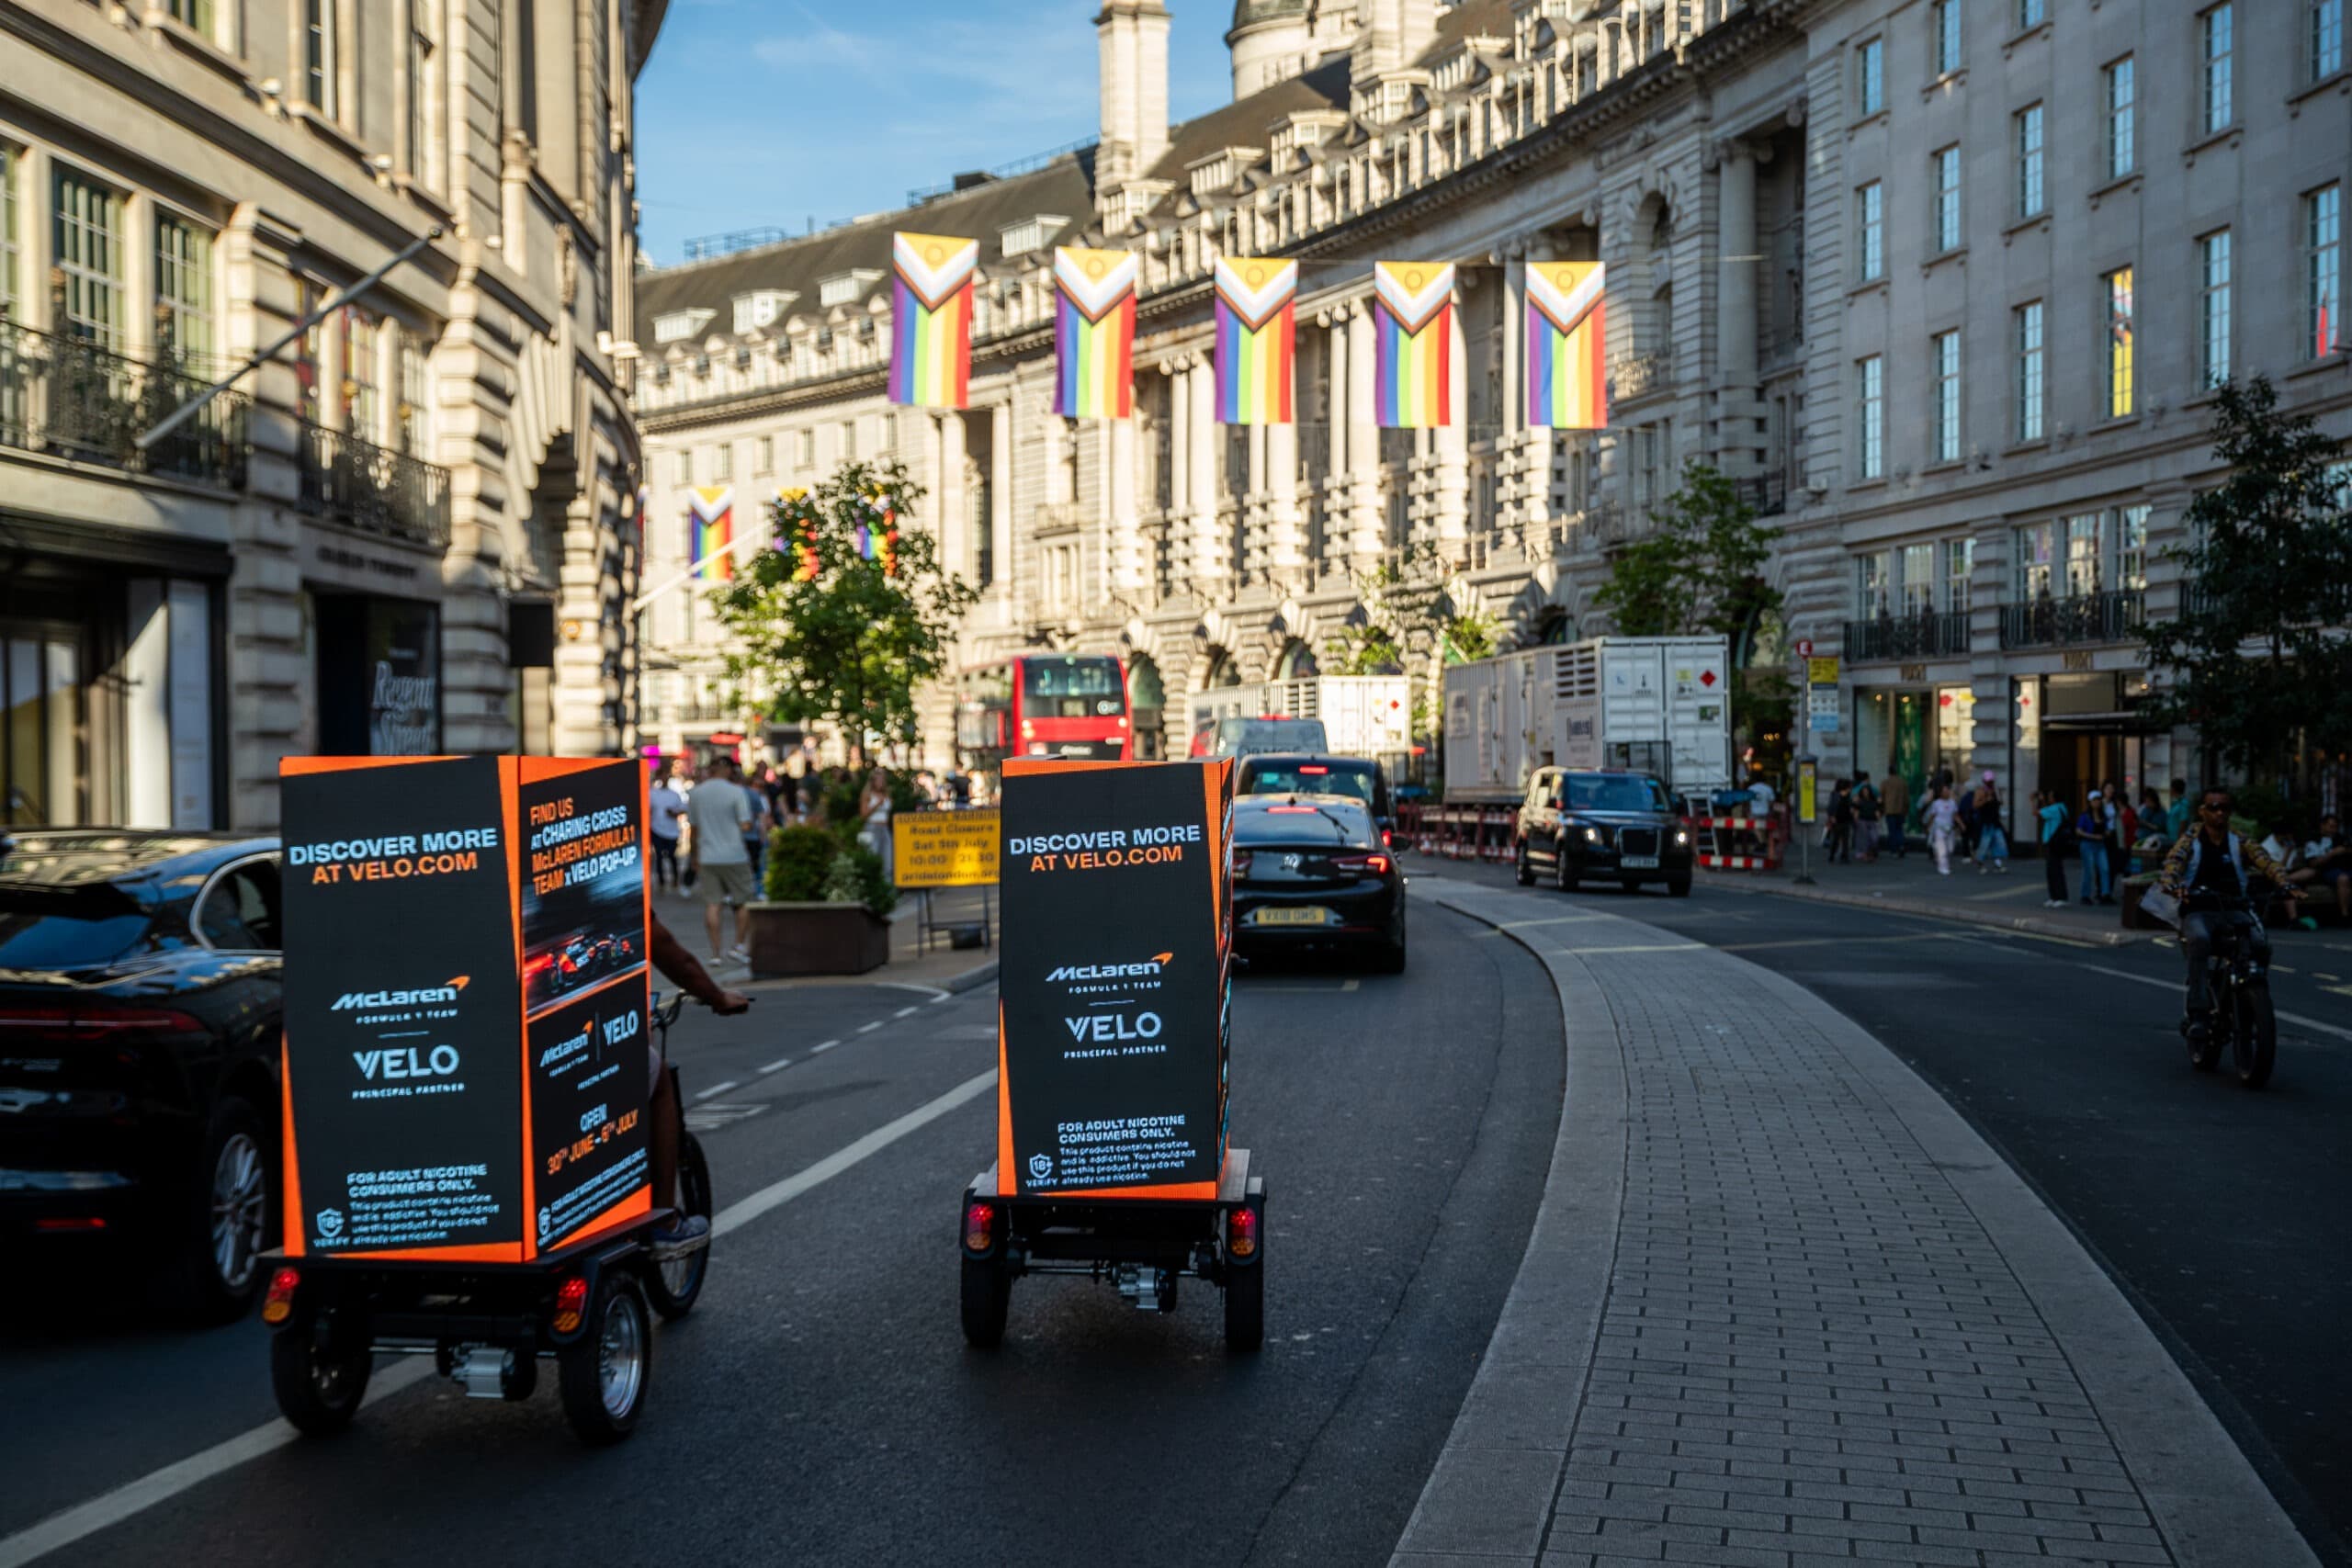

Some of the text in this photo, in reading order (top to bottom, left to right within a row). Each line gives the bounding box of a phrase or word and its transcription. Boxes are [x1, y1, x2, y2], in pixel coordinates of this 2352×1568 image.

[530, 796, 573, 827] FIND US
[531, 805, 627, 851] AT CHARING CROSS
[288, 828, 498, 865] DISCOVER MORE
[532, 840, 582, 874] McLAREN
[582, 828, 629, 856] FORMULA
[1010, 825, 1201, 855] DISCOVER MORE
[311, 852, 479, 885] AT VELO.COM
[1030, 845, 1182, 873] AT VELO.COM
[533, 868, 564, 897] TEAM
[571, 856, 599, 883] VELO
[599, 845, 638, 874] POP-UP
[1046, 962, 1160, 982] McLaren
[331, 987, 457, 1010] McLaren
[1069, 984, 1118, 995] FORMULA
[1134, 980, 1161, 990] TEAM
[356, 1012, 412, 1024] FORMULA
[427, 1009, 458, 1019] TEAM
[1065, 1011, 1162, 1043] VELO
[540, 1010, 639, 1067] McLaren VELO
[353, 1044, 459, 1080] VELO
[1064, 1044, 1167, 1059] PRINCIPAL PARTNER
[352, 1083, 465, 1100] PRINCIPAL PARTNER
[580, 1102, 607, 1133] OPEN
[1057, 1114, 1185, 1134] FOR ADULT NICOTINE
[569, 1133, 595, 1163] JUNE
[616, 1109, 639, 1135] JULY
[1059, 1127, 1175, 1145] CONSUMERS ONLY.
[1059, 1140, 1189, 1156] This product contains nicotine
[1060, 1157, 1078, 1166] and
[1133, 1152, 1150, 1160] You
[1151, 1150, 1180, 1159] should
[1181, 1149, 1196, 1157] not
[346, 1163, 487, 1185] FOR ADULT NICOTINE
[1061, 1168, 1078, 1176] use
[1078, 1166, 1095, 1175] this
[1096, 1162, 1131, 1175] product
[1140, 1161, 1156, 1171] you
[1157, 1160, 1170, 1168] do
[1170, 1160, 1185, 1168] not
[348, 1179, 435, 1198] CONSUMERS
[1025, 1178, 1058, 1188] VERIFY
[1061, 1175, 1094, 1185] already
[1095, 1174, 1112, 1183] use
